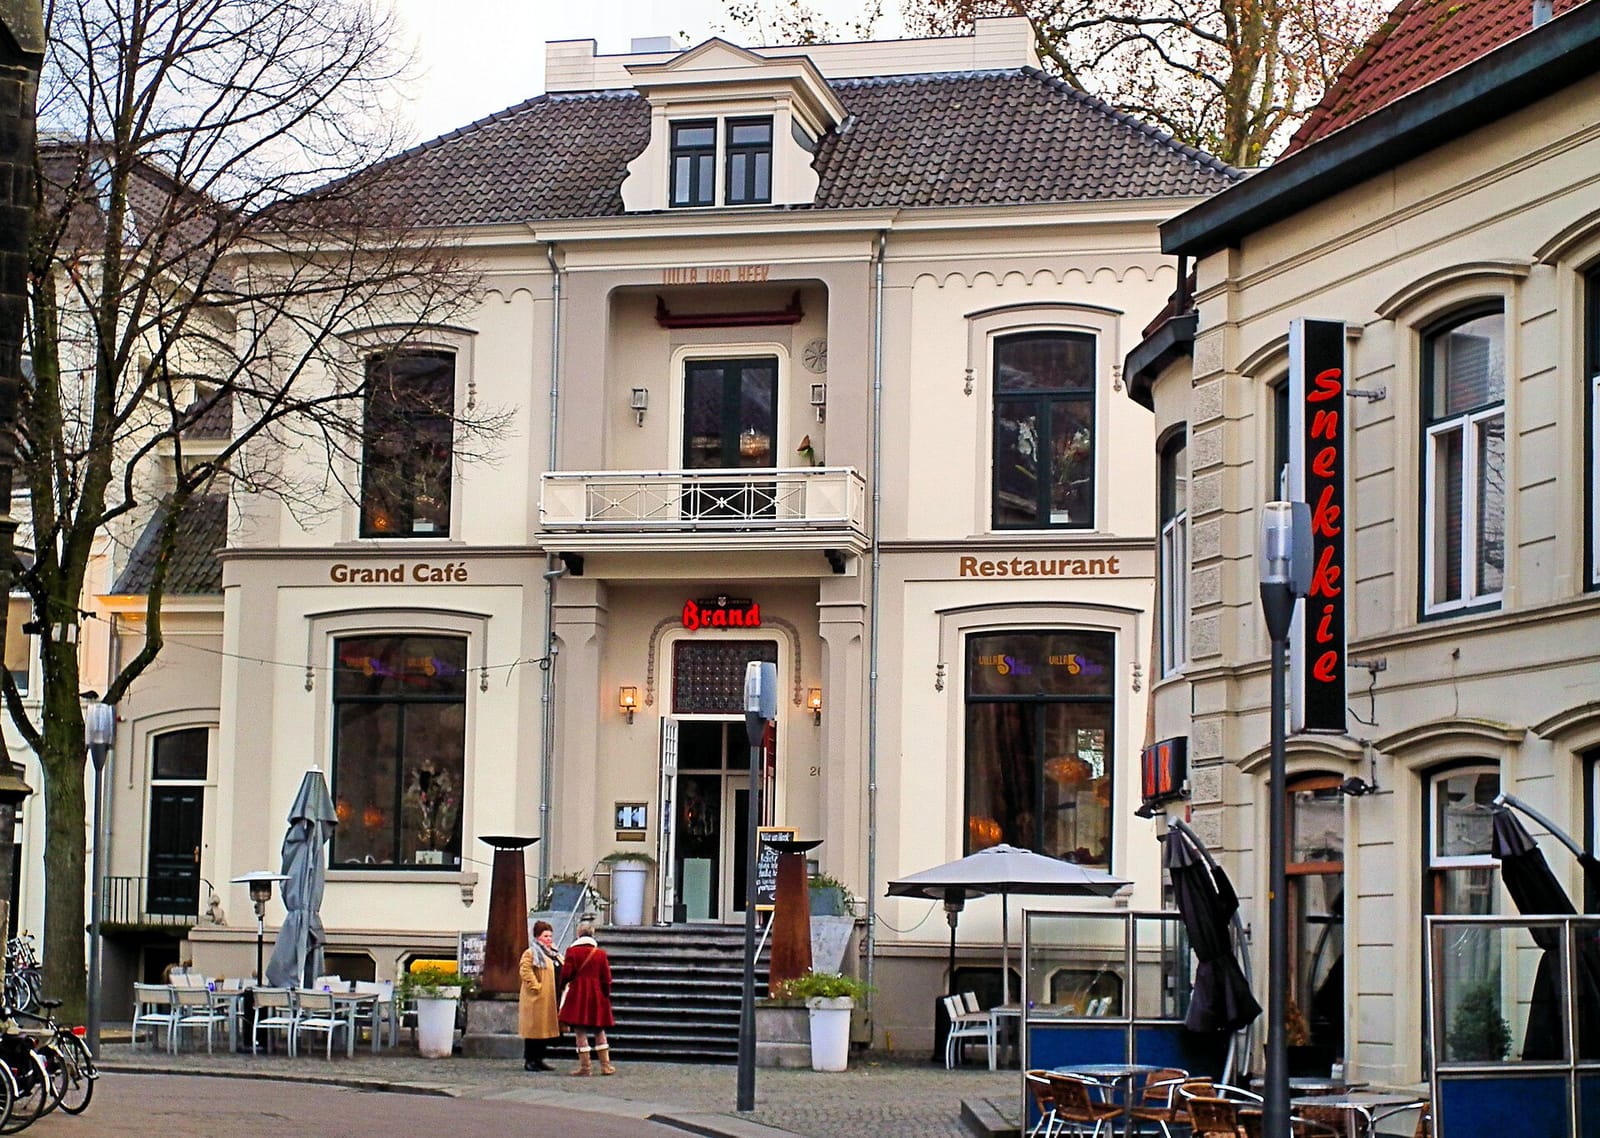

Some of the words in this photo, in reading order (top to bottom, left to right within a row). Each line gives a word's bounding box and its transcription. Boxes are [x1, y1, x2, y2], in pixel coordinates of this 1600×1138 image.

[330, 563, 405, 583] Grand
[412, 561, 468, 582] Café
[960, 555, 1120, 577] Restaurant
[682, 599, 761, 632] Brand
